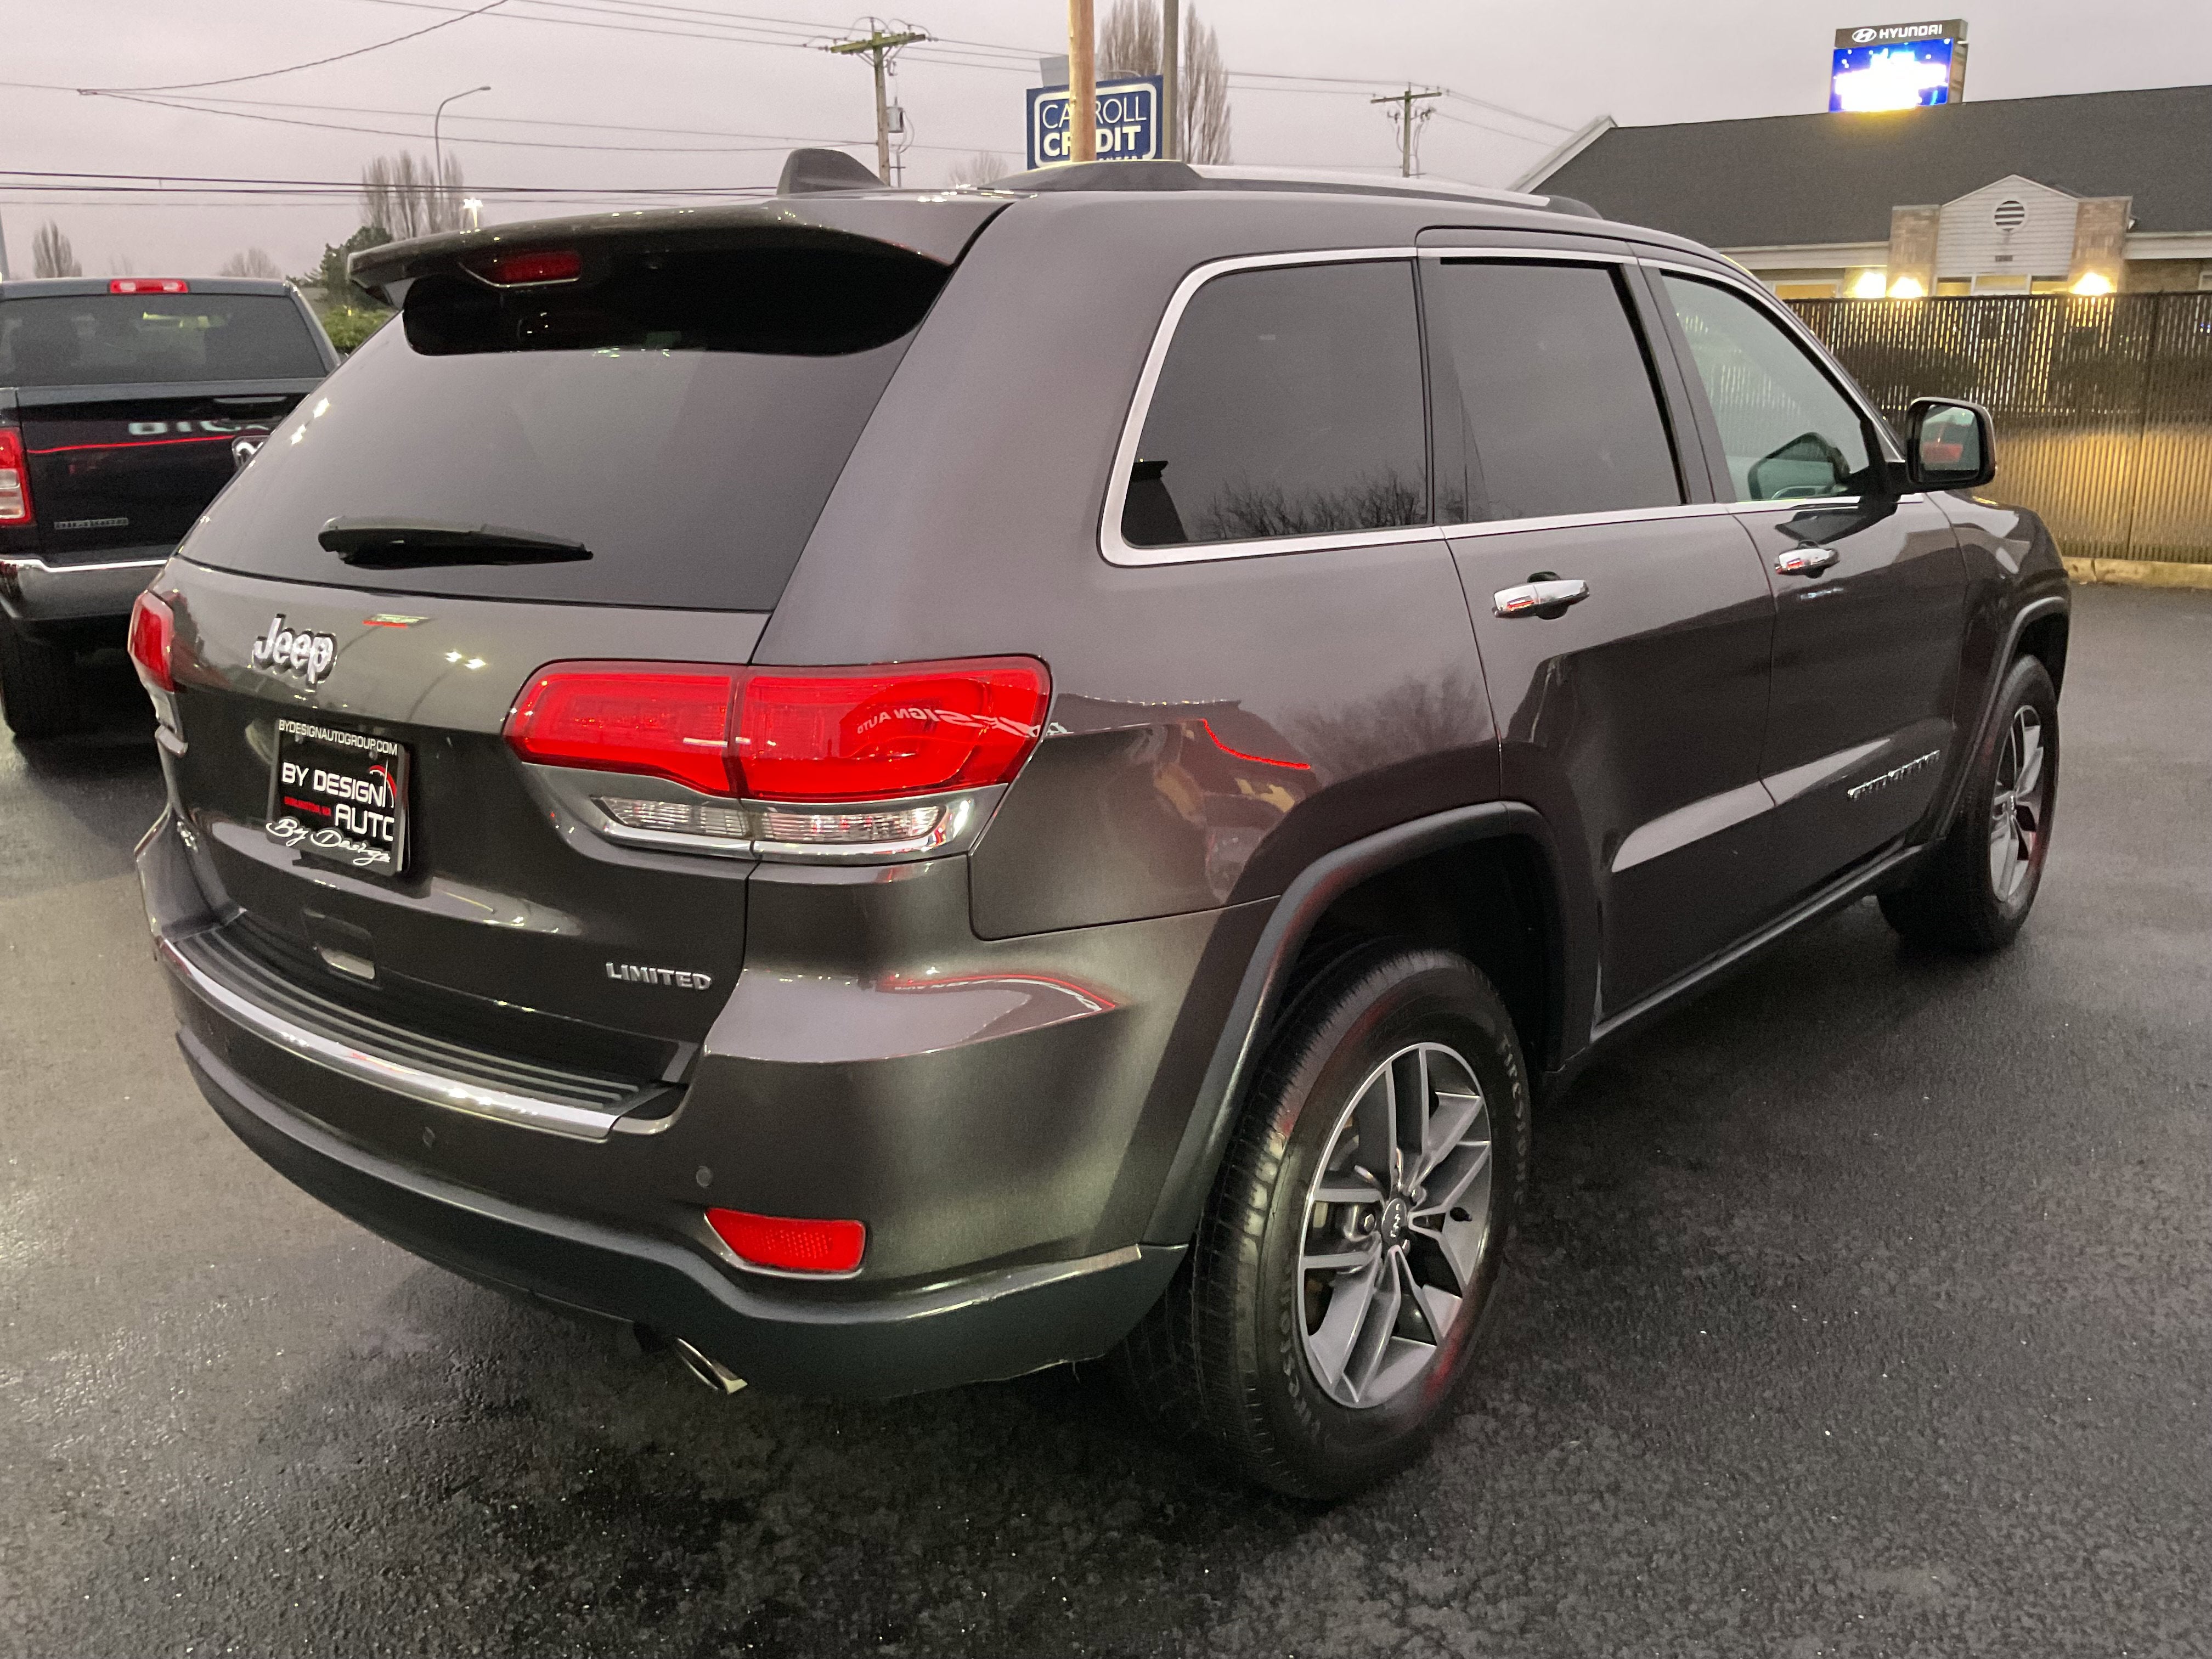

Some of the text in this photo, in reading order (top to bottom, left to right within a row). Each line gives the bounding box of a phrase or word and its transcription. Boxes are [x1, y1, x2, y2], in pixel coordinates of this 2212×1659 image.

[1879, 24, 1943, 39] HYUNDAI
[1042, 96, 1147, 129] CAROLL
[1043, 125, 1141, 156] CRDIT
[253, 614, 336, 687] Jeep
[279, 719, 398, 756] BYDESIGNAUTOGROUP.COM
[282, 762, 309, 786] BY
[313, 769, 383, 807] DESIGN
[266, 818, 390, 866] By Design
[606, 962, 712, 990] LIMITED
